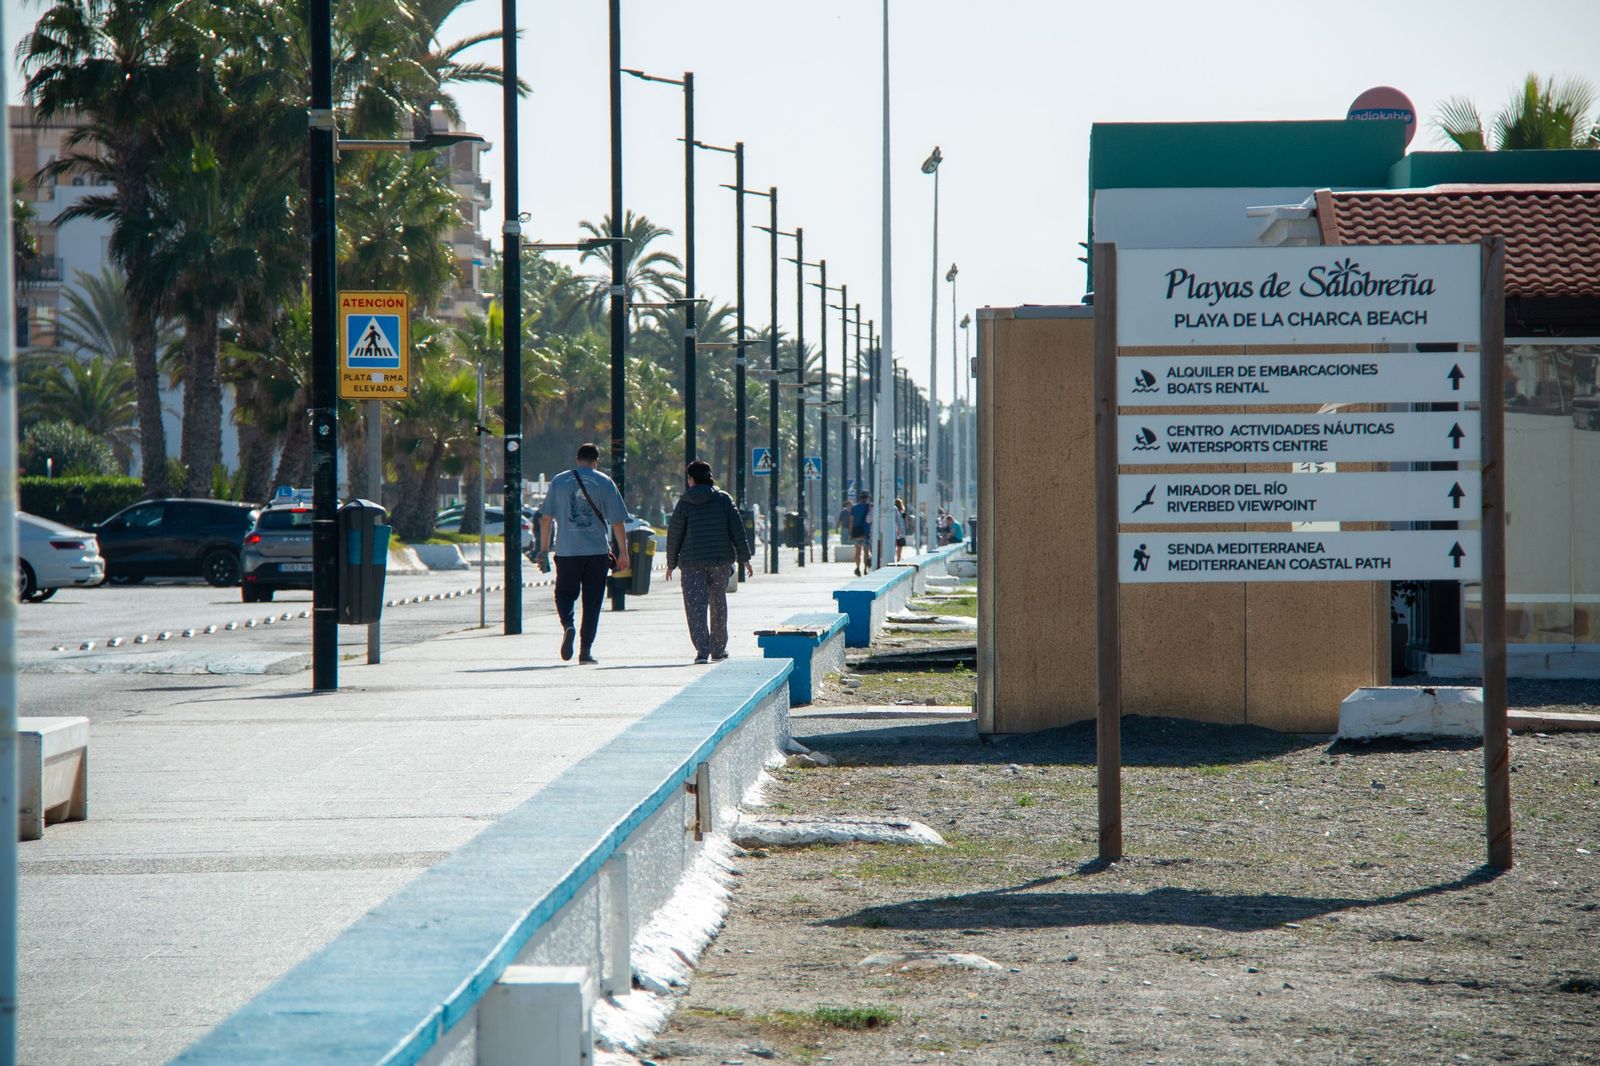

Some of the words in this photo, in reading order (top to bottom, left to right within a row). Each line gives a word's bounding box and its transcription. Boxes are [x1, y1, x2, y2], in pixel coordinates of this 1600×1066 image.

[1165, 268, 1253, 306] Playas
[1259, 272, 1292, 298] de
[1300, 264, 1436, 298] Salobreña
[342, 296, 404, 308] ATENCIÓN
[1174, 313, 1229, 328] PLAYA
[1233, 313, 1257, 327] DE
[1261, 312, 1284, 327] LA
[1287, 311, 1363, 326] CHARCA
[1367, 310, 1428, 326] BEACH
[343, 373, 404, 382] PLATARMA
[1166, 366, 1235, 378] ALQUILER
[1237, 366, 1257, 377] DE
[1259, 364, 1379, 377] EMBARCACIONES
[1167, 382, 1212, 394] BOATS
[1216, 382, 1269, 394] RENTAL
[1167, 425, 1224, 437] CENTRO
[1230, 423, 1320, 436] ACTIVIDADES
[1323, 420, 1395, 435] NÁUTICAS
[1167, 440, 1270, 454] WATERSPORTS
[1272, 440, 1328, 452] CENTRE
[1167, 484, 1231, 496] MIRADOR
[1234, 484, 1261, 496] DEL
[1264, 480, 1288, 495] RÍO
[1167, 501, 1235, 513] RIVERBED
[1239, 499, 1317, 512] VIEWPOINT
[1167, 543, 1215, 555] SENDA
[1217, 542, 1325, 554] MEDITERRANEA
[1168, 558, 1286, 571] MEDITERRANEAN
[1289, 557, 1352, 570] COASTAL
[1355, 557, 1392, 569] PATH
